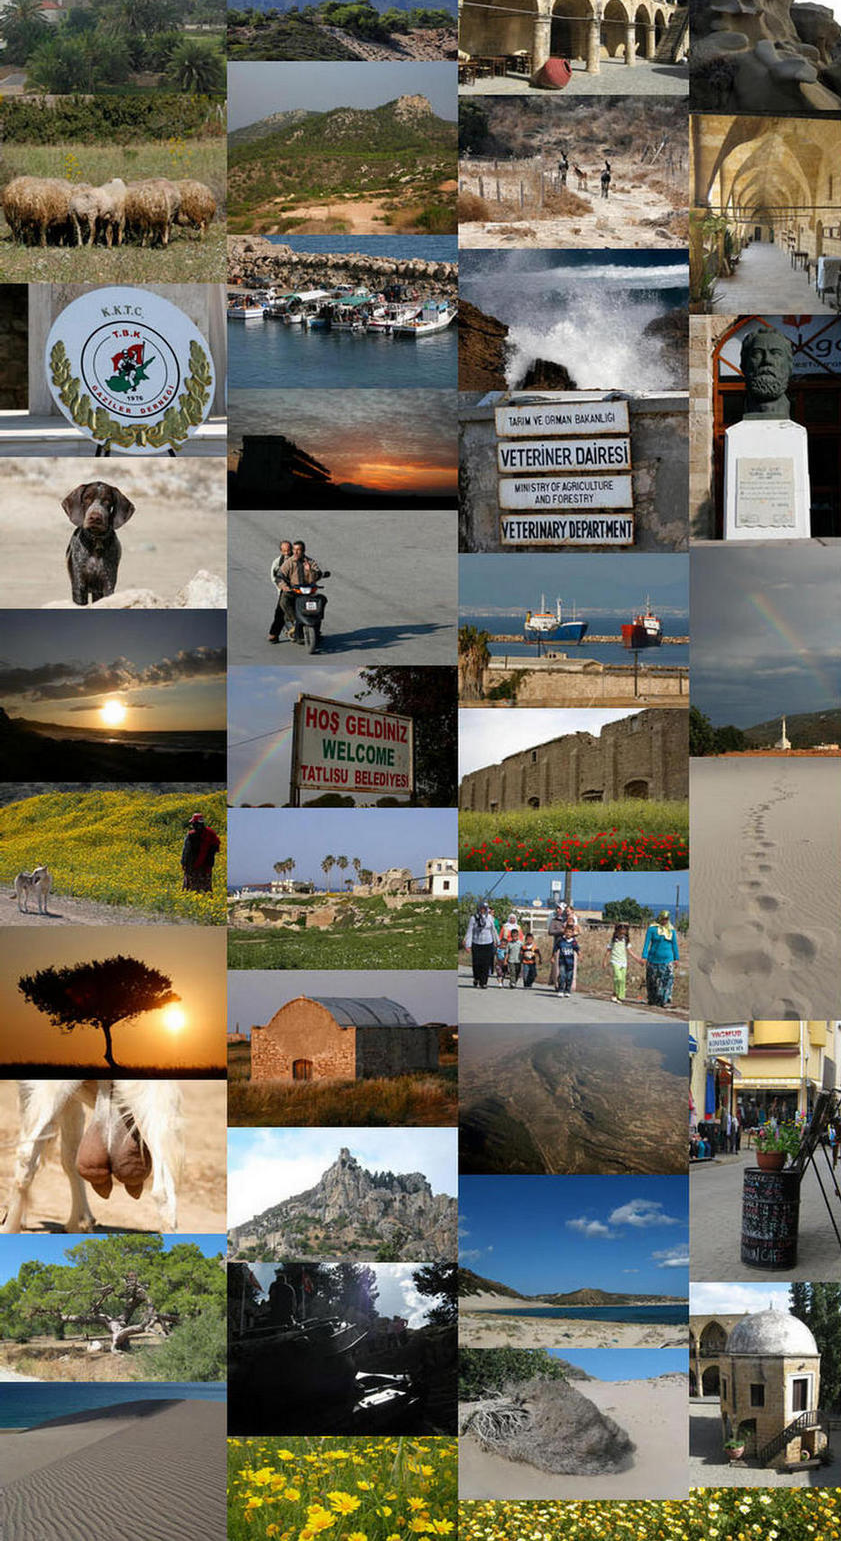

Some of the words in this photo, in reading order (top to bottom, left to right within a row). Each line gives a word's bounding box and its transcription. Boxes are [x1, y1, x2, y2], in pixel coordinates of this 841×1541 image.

[509, 416, 531, 426] TARIM
[533, 416, 543, 425] VE
[545, 415, 572, 425] ORMAN
[501, 444, 571, 467] VETERİNER
[575, 440, 629, 465] DAİRESİ
[514, 482, 550, 493] MINISTRY
[551, 482, 561, 492] OF
[562, 480, 614, 492] AGRICULTURE
[534, 494, 551, 505] AND
[552, 493, 594, 505] FORESTRY
[502, 521, 567, 539] VETERINARY
[569, 520, 632, 539] DEPARTMENT
[306, 706, 340, 735] HOŞ
[345, 715, 408, 744] GELDİNİZ
[323, 739, 395, 766] WELCOME
[301, 765, 349, 784] TATLISU
